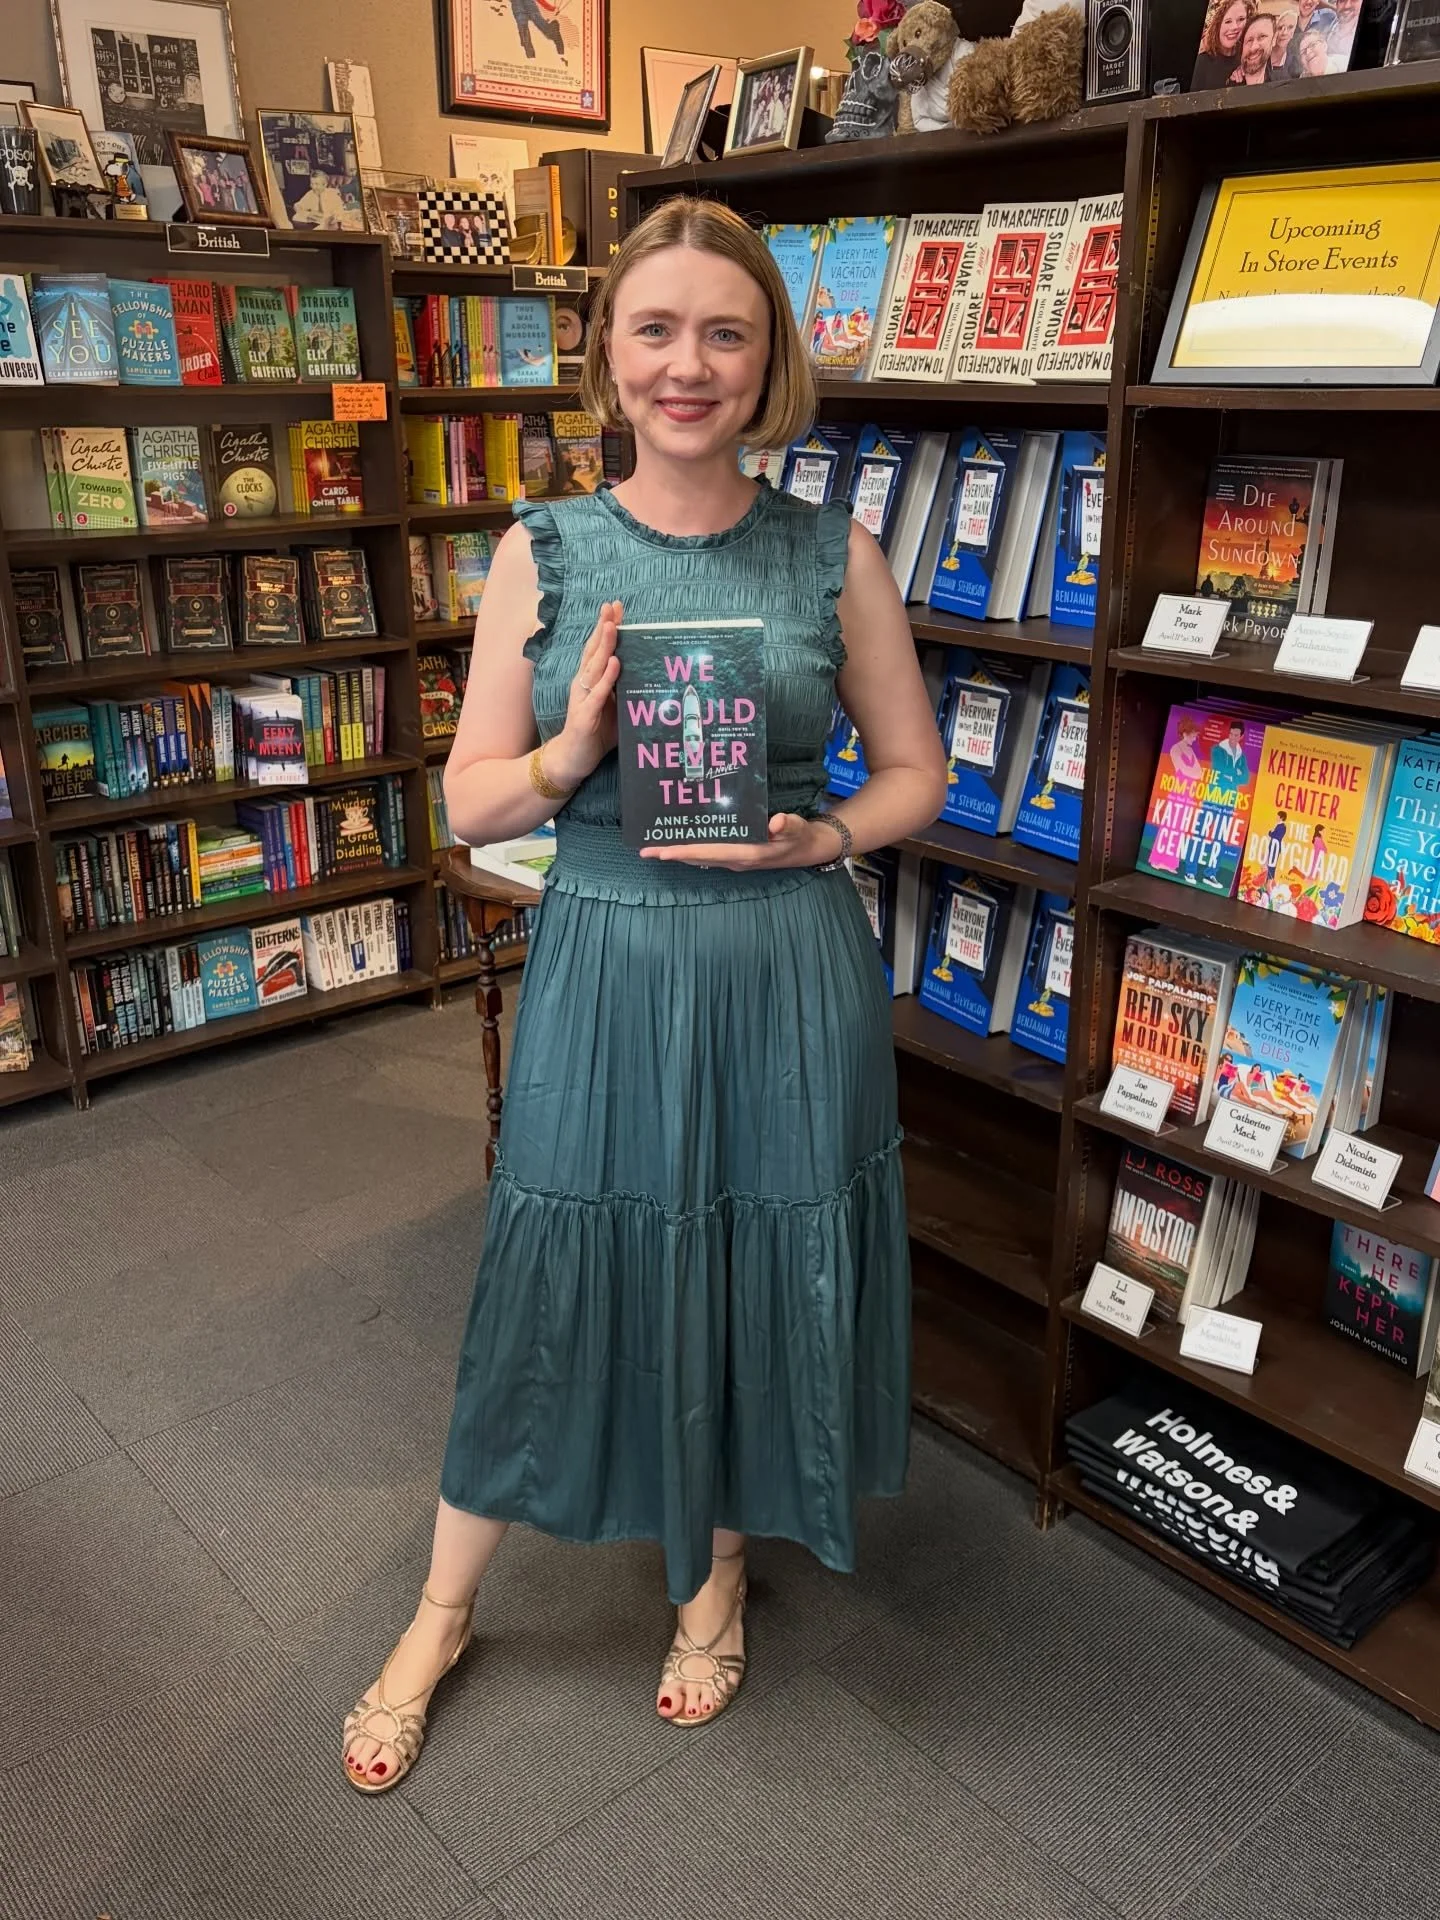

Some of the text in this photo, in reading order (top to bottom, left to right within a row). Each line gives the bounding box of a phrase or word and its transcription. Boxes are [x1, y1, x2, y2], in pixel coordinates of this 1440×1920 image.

[0, 149, 35, 161] POISON
[987, 207, 1069, 228] 10 MARCHFIELD
[1080, 204, 1093, 222] 10
[913, 220, 923, 237] 10
[1270, 217, 1382, 243] Upcoming
[198, 233, 241, 250] British
[836, 250, 861, 259] EVERY
[1036, 232, 1063, 292] SQUARE
[1239, 247, 1399, 273] In Store Events
[952, 242, 978, 297] SQUARE
[535, 272, 568, 287] British
[130, 291, 149, 299] THE
[239, 296, 283, 311] STRANGER
[301, 296, 349, 308] STRANGER
[840, 290, 861, 301] DIES
[70, 303, 76, 316] I
[112, 300, 173, 320] FELLOWSHIP
[242, 311, 276, 326] DIARIES
[303, 311, 341, 323] DIARIES
[1042, 289, 1070, 347] SQUARE
[52, 320, 100, 339] SEE
[884, 296, 906, 349] SQUARE
[962, 292, 984, 349] SQUARE
[121, 337, 168, 350] PUZZLE
[49, 344, 112, 364] YOU
[122, 349, 172, 362] MAKERS
[307, 349, 328, 361] ELLY
[1036, 352, 1102, 371] MARCHFIELD
[251, 365, 297, 379] GRIFFITHS
[308, 364, 357, 376] GRIFFITHS
[879, 354, 944, 374] 10 MARCHFIELD
[958, 356, 1032, 376] 10 MARCHFIELD
[142, 430, 197, 444] AGATHA
[304, 422, 357, 436] AGATHA
[556, 426, 600, 438] CHRISTIE
[71, 438, 121, 459] Agatha
[220, 431, 269, 450] Agatha
[304, 435, 359, 450] CHRISTIE
[143, 444, 199, 458] CHRISTIE
[221, 448, 270, 464] Christie
[71, 456, 122, 472] Christie
[147, 460, 198, 471] FIVE LITTLE
[163, 470, 185, 481] PIGS
[795, 470, 826, 483] EVERYONE
[861, 477, 888, 490] EVERYONE
[80, 482, 123, 495] TOWARDS
[236, 483, 263, 494] CLOCKS
[322, 486, 349, 496] CARDS
[805, 485, 824, 497] BANK
[964, 483, 994, 499] EVERYONE
[1243, 484, 1278, 508] DIE
[78, 492, 126, 510] ZERO
[337, 496, 360, 505] TABLE
[868, 493, 885, 506] BANK
[973, 501, 990, 516] BANK
[862, 509, 882, 525] THIEF
[967, 518, 988, 537] THIEF
[958, 580, 986, 598] STEVENSON
[1056, 590, 1095, 608] BENJAMIN
[1178, 603, 1202, 616] Mark
[1173, 616, 1198, 630] Pryor
[663, 655, 715, 683] WE
[153, 706, 165, 737] ARCHER
[626, 698, 757, 728] WOULD
[960, 704, 997, 722] EVERYONE
[34, 724, 89, 745] ARCHER
[263, 726, 295, 739] EENY
[973, 722, 994, 737] BANK
[259, 742, 302, 756] MEENY
[637, 740, 749, 769] NEVER
[967, 737, 992, 757] THIEF
[55, 769, 94, 784] EYE FOR
[715, 762, 741, 775] NOVEL
[1199, 767, 1222, 786] THE
[1267, 748, 1363, 793] KATHERINE
[52, 783, 85, 797] AN EYE
[658, 778, 727, 805] TELL
[1160, 773, 1252, 811] ROM-COMMERS
[332, 797, 376, 811] Murders
[958, 795, 996, 816] STEVENSON
[1275, 782, 1341, 821] CENTER
[654, 813, 739, 827] ANNE-SOPHIE
[1018, 810, 1051, 831] BENJAMIN
[1151, 798, 1245, 846] KATHERINE
[347, 829, 378, 844] Great
[643, 825, 750, 841] JOUHANNEAU
[1288, 820, 1312, 844] THE
[336, 845, 382, 860] Diddling
[1156, 826, 1222, 869] CENTER
[1247, 833, 1350, 888] BODYGUARD
[1381, 846, 1437, 882] Save
[953, 905, 986, 928] EVERYONE
[255, 927, 301, 950] BITTERNS
[964, 926, 985, 943] BANK
[200, 945, 250, 966] FELLOWSHIP
[959, 938, 982, 960] THIEF
[208, 973, 247, 988] PUZZLE
[208, 982, 249, 998] MAKERS
[1126, 971, 1215, 1003] JOE PAPPALARDO
[923, 977, 987, 1017] BENJAMIN STEVENSON
[1253, 994, 1291, 1014] EVERY
[1124, 987, 1210, 1043] RED SKY
[1016, 1014, 1051, 1038] BENJAMIN
[1121, 1021, 1202, 1068] MORNING
[1254, 1029, 1304, 1054] Someone
[1260, 1042, 1291, 1064] DIES
[1118, 1048, 1200, 1085] TEXAS RANGER
[1134, 1078, 1148, 1091] Joe
[1117, 1084, 1158, 1109] Pappalardo
[1229, 1108, 1272, 1132] Catherine
[1232, 1123, 1257, 1142] Mack
[1345, 1142, 1377, 1164] Nicolas
[1334, 1153, 1377, 1180] Didomizio
[1155, 1163, 1205, 1197] ROSS
[1111, 1188, 1197, 1269] IMPOSTOR
[1342, 1228, 1421, 1281] THERE
[1371, 1263, 1400, 1291] HE
[1109, 1290, 1126, 1306] Ross
[1337, 1275, 1399, 1321] KEPT
[1355, 1305, 1406, 1346] HER
[1329, 1318, 1409, 1366] JOSHUA MOEHLING
[1145, 1408, 1299, 1516] Holmes&
[1112, 1428, 1260, 1537] Watson&
